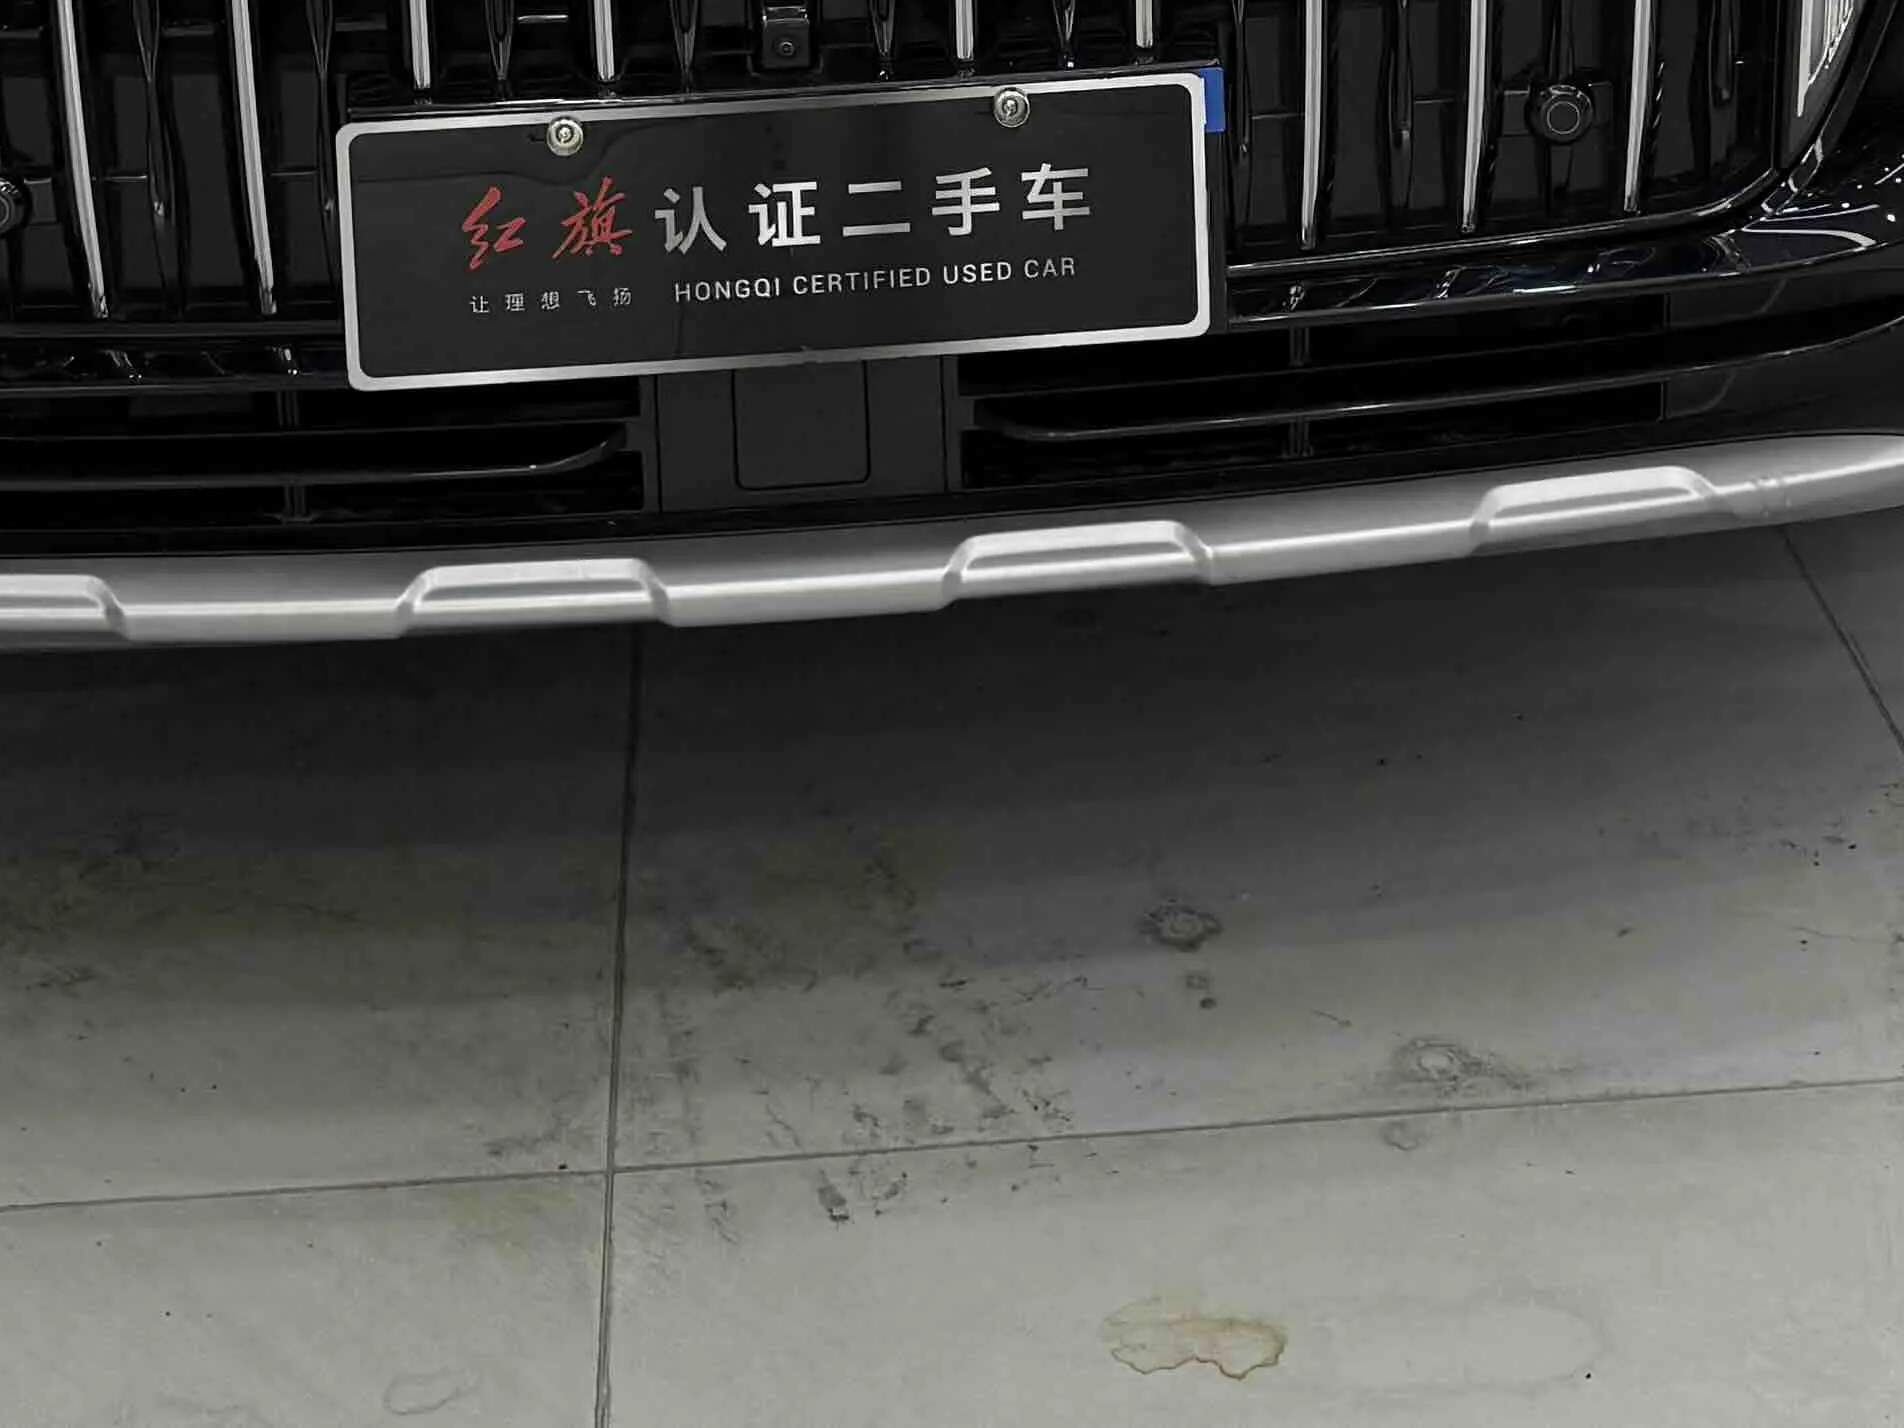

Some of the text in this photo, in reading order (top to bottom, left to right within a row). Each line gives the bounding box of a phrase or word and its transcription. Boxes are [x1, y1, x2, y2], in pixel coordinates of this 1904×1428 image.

[674, 256, 1076, 304] HONGQI CERTIFIED USED CAR
[469, 287, 633, 315] 让理想飞扬
